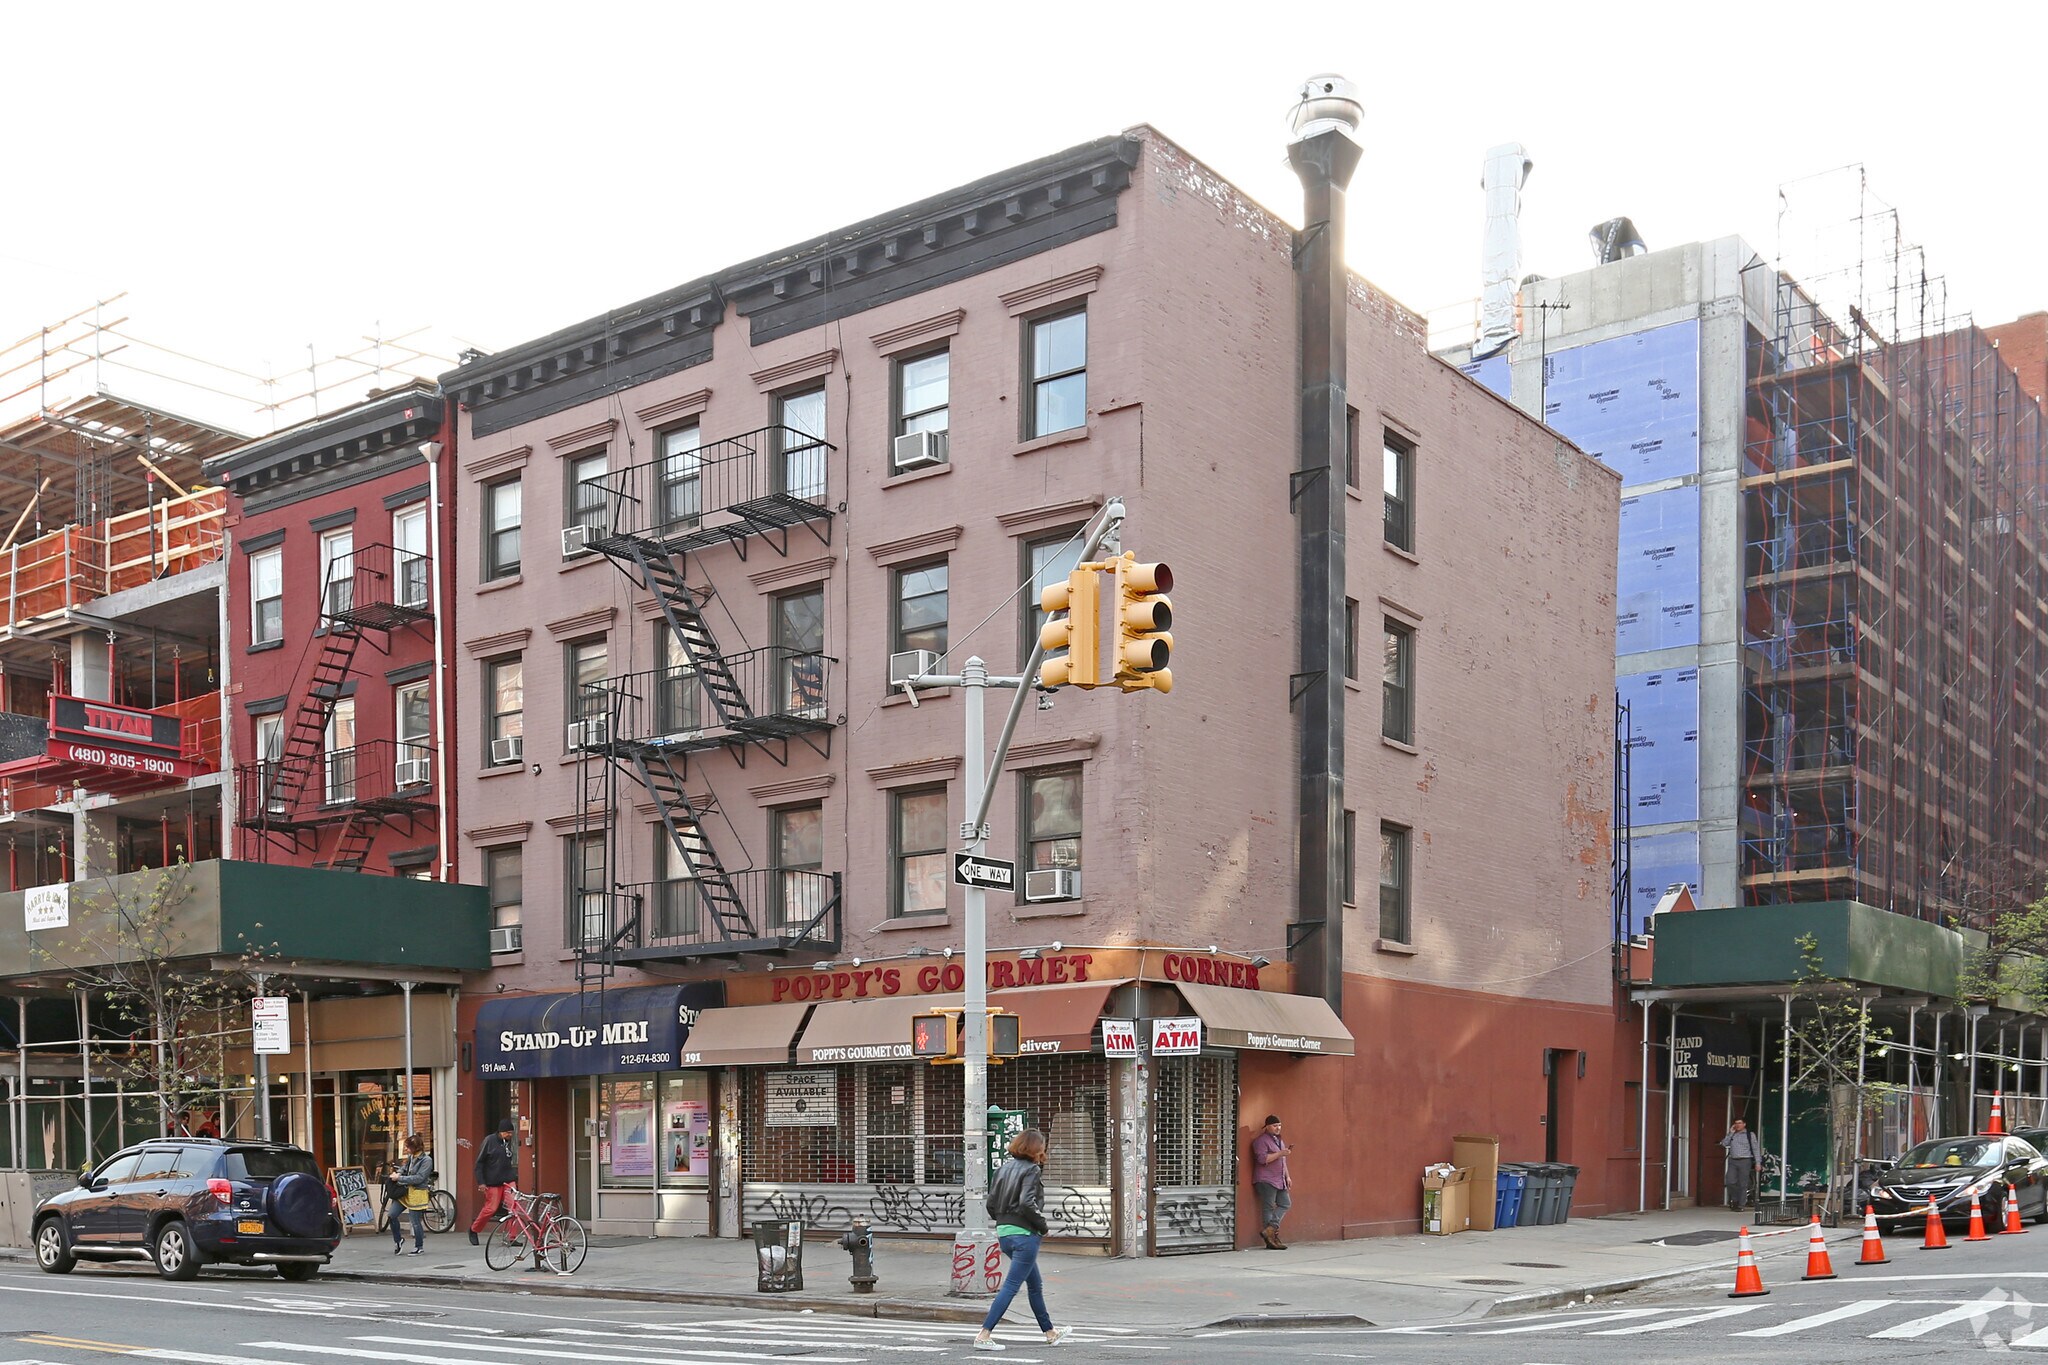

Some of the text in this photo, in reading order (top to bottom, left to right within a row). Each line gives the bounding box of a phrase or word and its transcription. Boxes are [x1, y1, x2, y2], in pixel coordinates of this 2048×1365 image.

[1588, 390, 1611, 400] National
[1630, 441, 1654, 450] National
[1643, 547, 1667, 556] National
[1662, 604, 1684, 613] National
[84, 707, 152, 736] TITAN
[69, 745, 174, 774] (480) 305-1900
[964, 864, 1007, 881] ONE WAY
[26, 892, 45, 914] HARRY
[771, 953, 1260, 1002] POPPY'S GORMET CORNER
[601, 1021, 649, 1045] MRI
[1155, 1031, 1199, 1048] ATM
[1247, 1032, 1321, 1050] Poppy's Gourmet Corner
[1020, 1039, 1061, 1053] elivery
[1106, 1034, 1136, 1050] ATM
[620, 1053, 670, 1065] 212-674-8300
[685, 1052, 702, 1063] 191
[812, 1044, 913, 1061] POPPY'S GOURMET COR
[481, 1062, 515, 1072] 191 Ave. A
[1736, 1055, 1750, 1069] MRI
[786, 1074, 816, 1084] SPACE
[776, 1087, 827, 1096] AVAILABLE
[360, 1094, 388, 1119] HARRY
[336, 1173, 367, 1196] BEST
